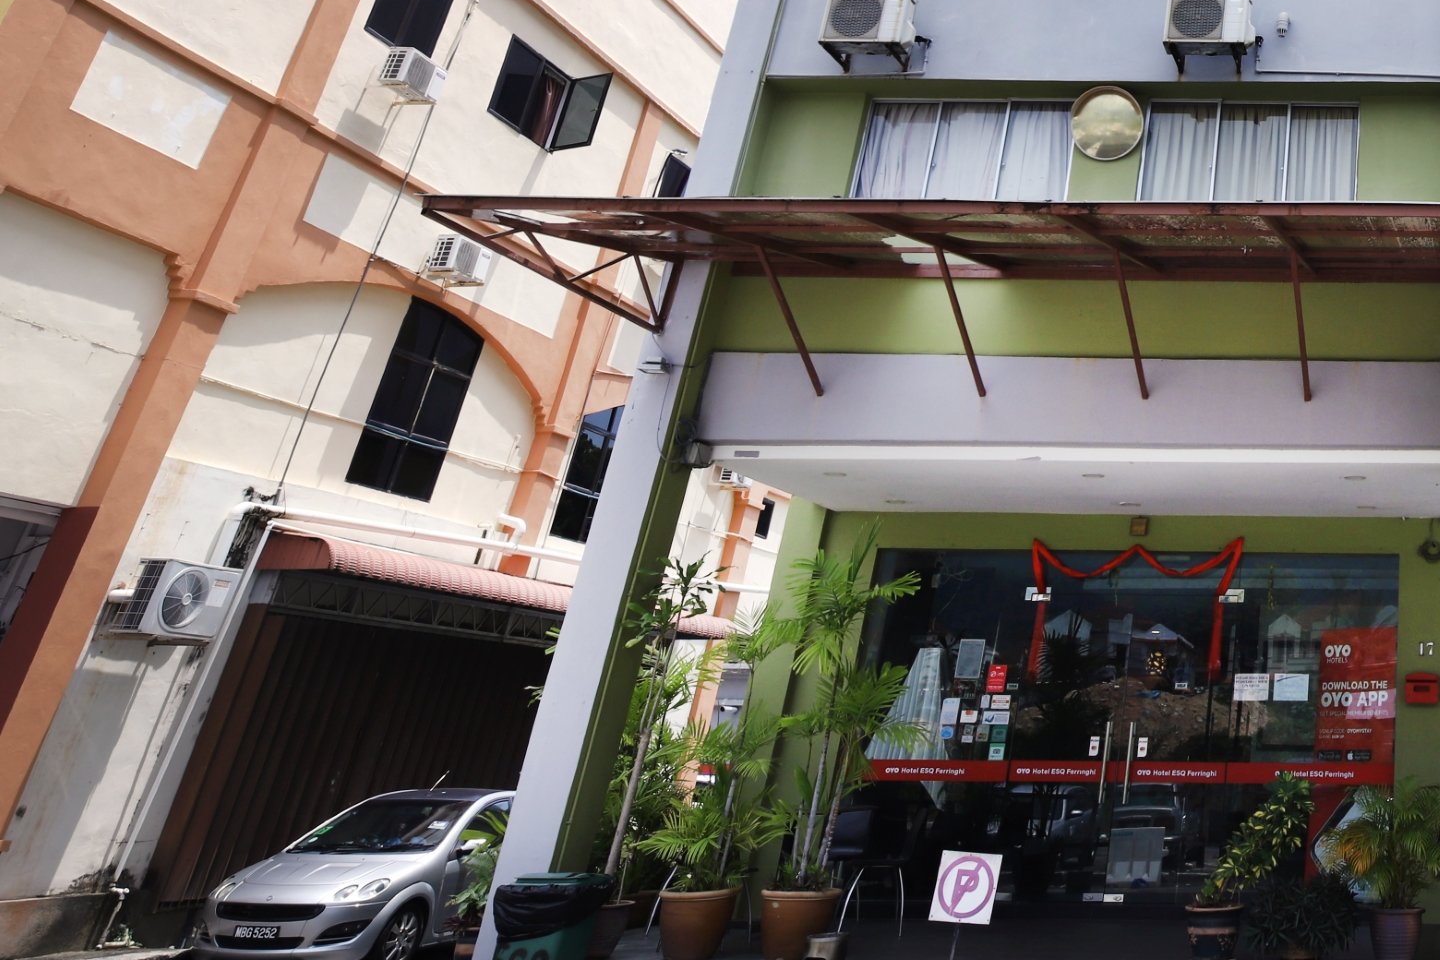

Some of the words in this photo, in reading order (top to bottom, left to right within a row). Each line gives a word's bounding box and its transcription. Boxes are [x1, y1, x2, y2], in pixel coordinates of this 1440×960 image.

[1325, 644, 1352, 658] OYO
[1420, 642, 1434, 656] 17
[1322, 681, 1369, 690] DOWNLOAD
[1370, 680, 1388, 689] THE
[1321, 691, 1353, 707] OYO
[1356, 690, 1389, 707] APP
[935, 768, 965, 776] Ferringhi
[1324, 771, 1354, 779] Ferringhi
[253, 927, 278, 939] 5252
